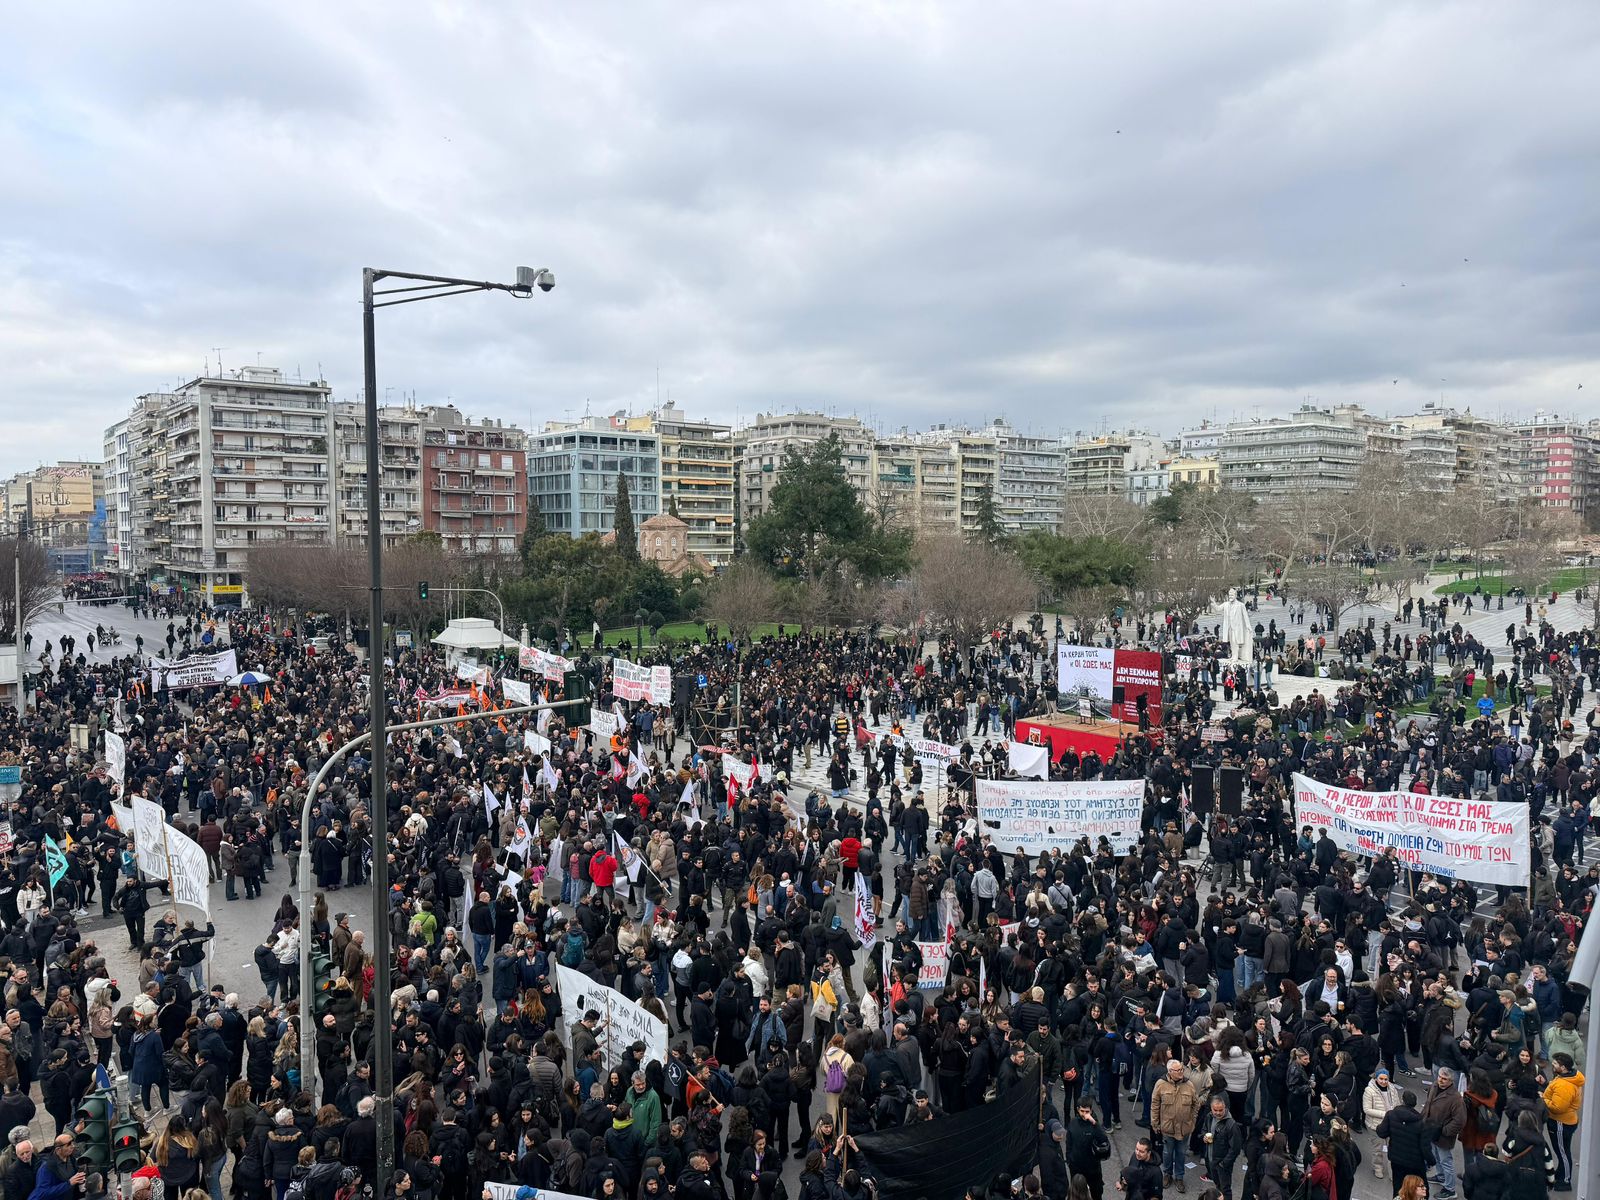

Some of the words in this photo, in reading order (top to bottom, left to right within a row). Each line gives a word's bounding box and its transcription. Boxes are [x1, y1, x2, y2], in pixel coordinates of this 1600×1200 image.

[1085, 650, 1099, 658] ΤΟΥΣ
[1075, 659, 1081, 668] ΟΙ
[1082, 660, 1098, 669] ΖΩΕΣ
[1099, 661, 1112, 670] ΜΑΣ
[1116, 667, 1128, 675] ΔΕΝ
[1129, 668, 1159, 678] ΞΕΧΝΑΜΕ
[186, 677, 201, 685] ΖΩΕΣ
[1116, 675, 1126, 683] ΔΕΝ
[1126, 676, 1159, 686] ΣΥΓΧΩΡΟΥΜΕ
[925, 742, 939, 752] ΖΩΕΣ
[940, 745, 951, 755] ΜΑΣ
[1326, 788, 1339, 802] ΤΑ
[1342, 792, 1373, 808] ΚΕΡΔΗ
[1378, 794, 1398, 808] ΤΟΥΣ
[1415, 797, 1425, 811] ΟΙ
[1429, 799, 1463, 817] ΖΩΕΣ
[1467, 803, 1493, 820] ΜΑΣ
[1299, 791, 1318, 804] ΠΟΤΕ
[1335, 804, 1346, 815] ΘΑ
[1348, 808, 1398, 823] ΞΕΧΑΣΟΥΜΕ
[1403, 811, 1415, 823] ΤΟ
[1458, 819, 1477, 833] ΣΤΑ
[1481, 821, 1513, 835] ΤΡΕΝΑ
[1300, 810, 1333, 827] ΑΓΩΝΑΣ
[1334, 817, 1347, 832] ΓΙΑ
[1388, 832, 1424, 850] ΔΟΥΛΕΙΑ
[1426, 836, 1443, 854] ΖΩΗ
[1445, 841, 1460, 857] ΣΤΟ
[1487, 846, 1512, 862] ΤΩΝ
[1398, 848, 1424, 864] ΜΑΣ
[1411, 863, 1456, 878] ΘΕΣΣΑΛΟΝΙΚΗΣ
